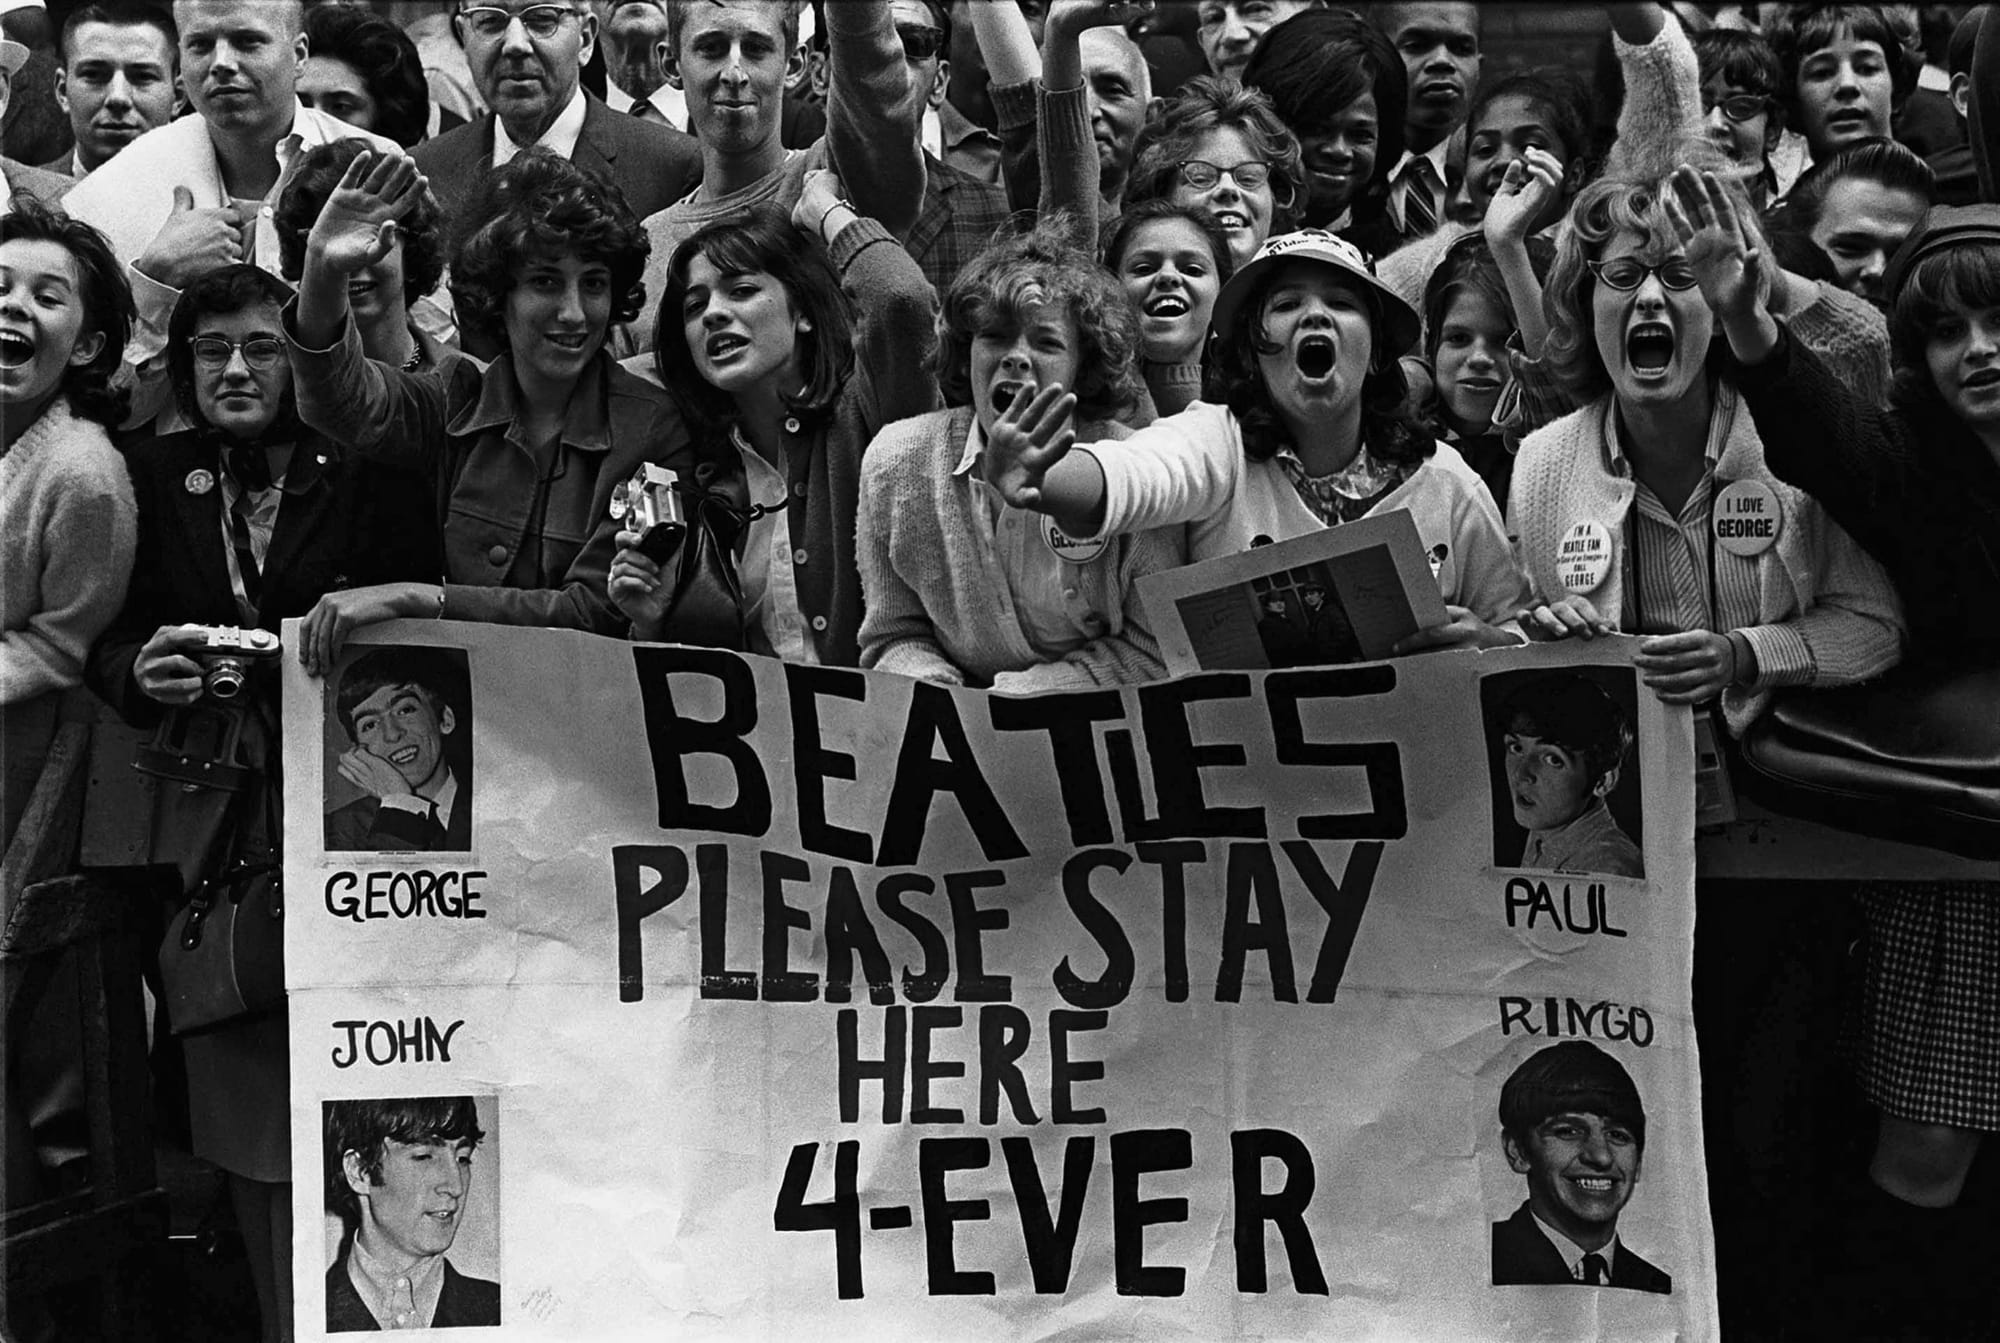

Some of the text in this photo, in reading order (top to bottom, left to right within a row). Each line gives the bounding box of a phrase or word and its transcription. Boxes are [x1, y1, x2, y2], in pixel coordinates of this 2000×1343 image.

[1586, 525, 1591, 535] A
[1717, 519, 1773, 537] GEORGE
[1726, 497, 1764, 513] I LOVE
[1563, 539, 1601, 553] BEATLE FAN
[1565, 572, 1595, 587] GEORGE
[633, 646, 1409, 868] BEATLES
[325, 870, 487, 922] GEORGE
[1504, 877, 1628, 938] PAUL
[613, 841, 1386, 1009] PLEASE STAY
[332, 1016, 465, 1069] JOHN
[1499, 997, 1654, 1048] RINGO
[837, 1004, 1110, 1126] HERE
[774, 1128, 1330, 1300] 4-EVER
